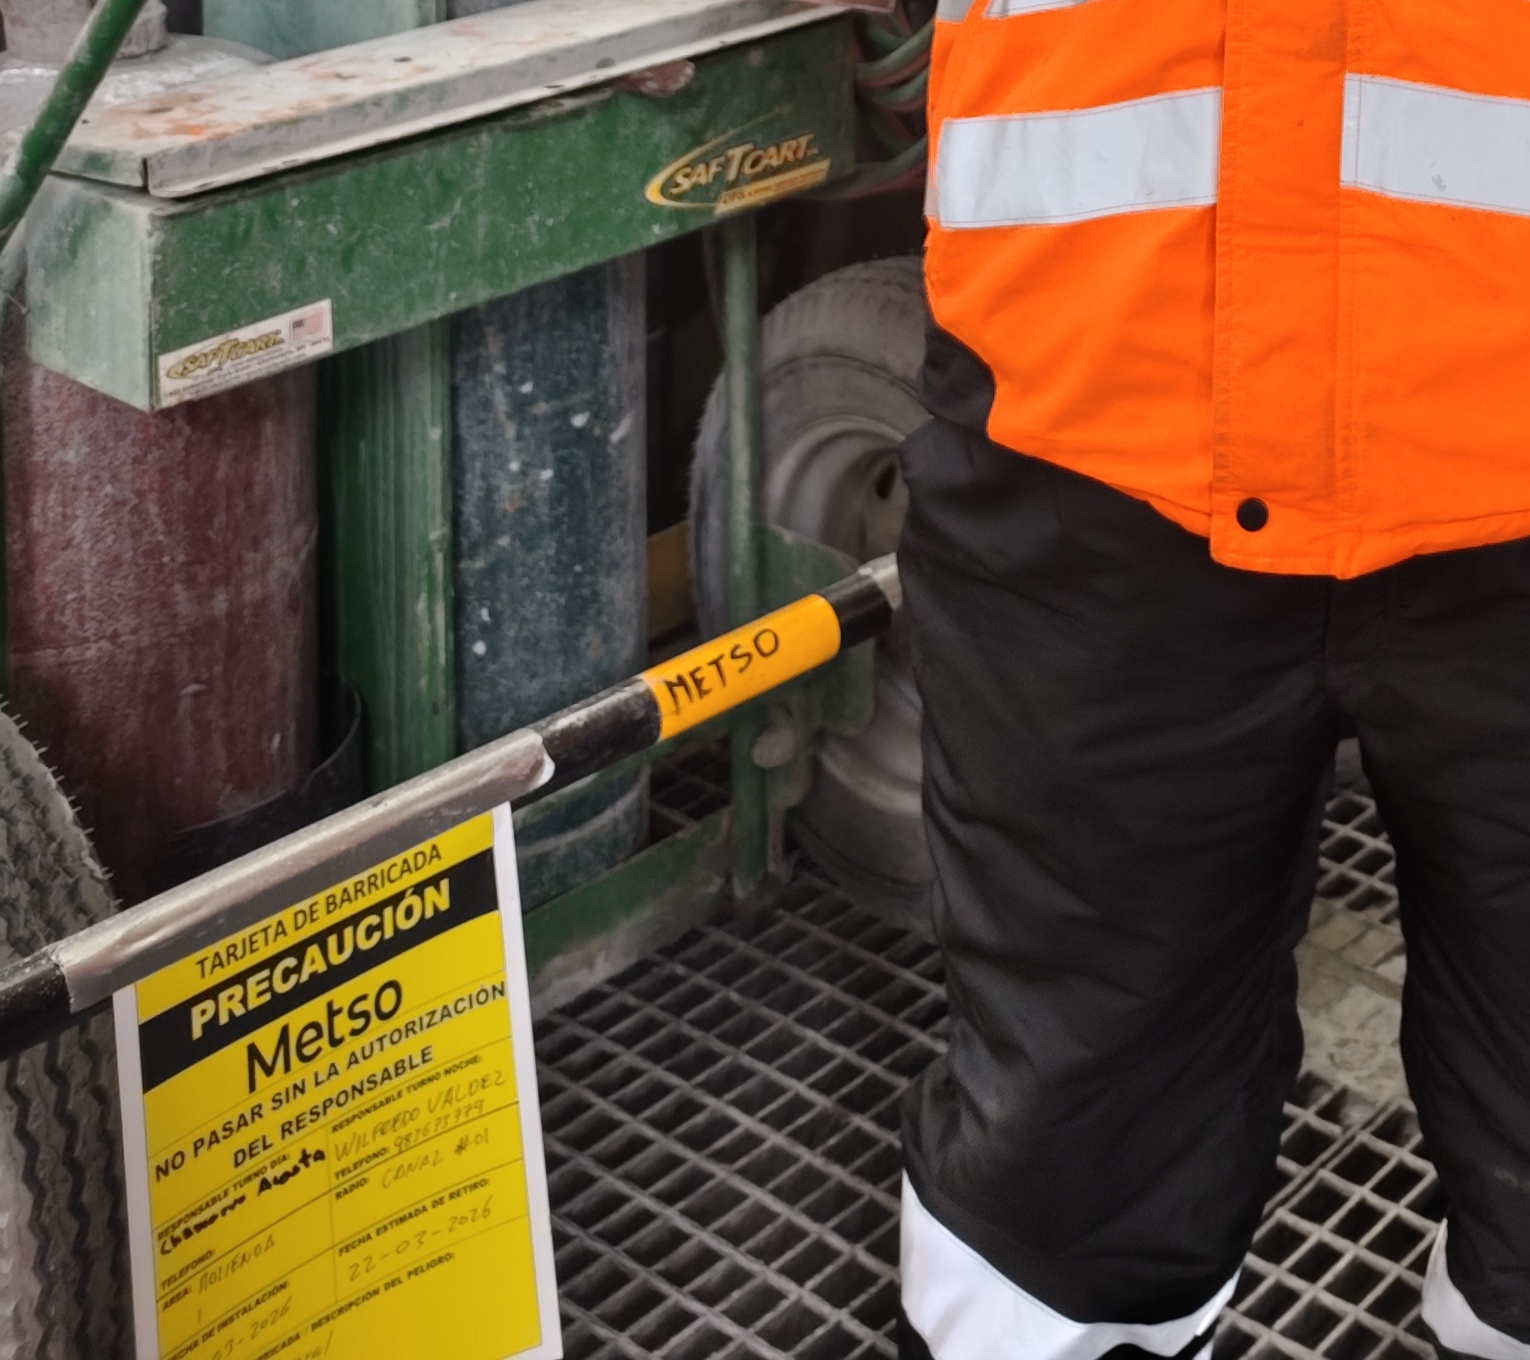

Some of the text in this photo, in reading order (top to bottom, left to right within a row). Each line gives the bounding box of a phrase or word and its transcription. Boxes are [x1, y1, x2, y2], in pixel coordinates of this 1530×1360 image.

[664, 628, 780, 715] METSO
[190, 878, 450, 1041] PRECAUCIÓN
[195, 843, 443, 980] TARJETA DE BARRICADA
[156, 981, 506, 1183] NO PASAR SIN LA AUTORIZACIÓN
[246, 979, 404, 1095] Metso
[234, 1044, 434, 1169] DEL RESPONSABLE
